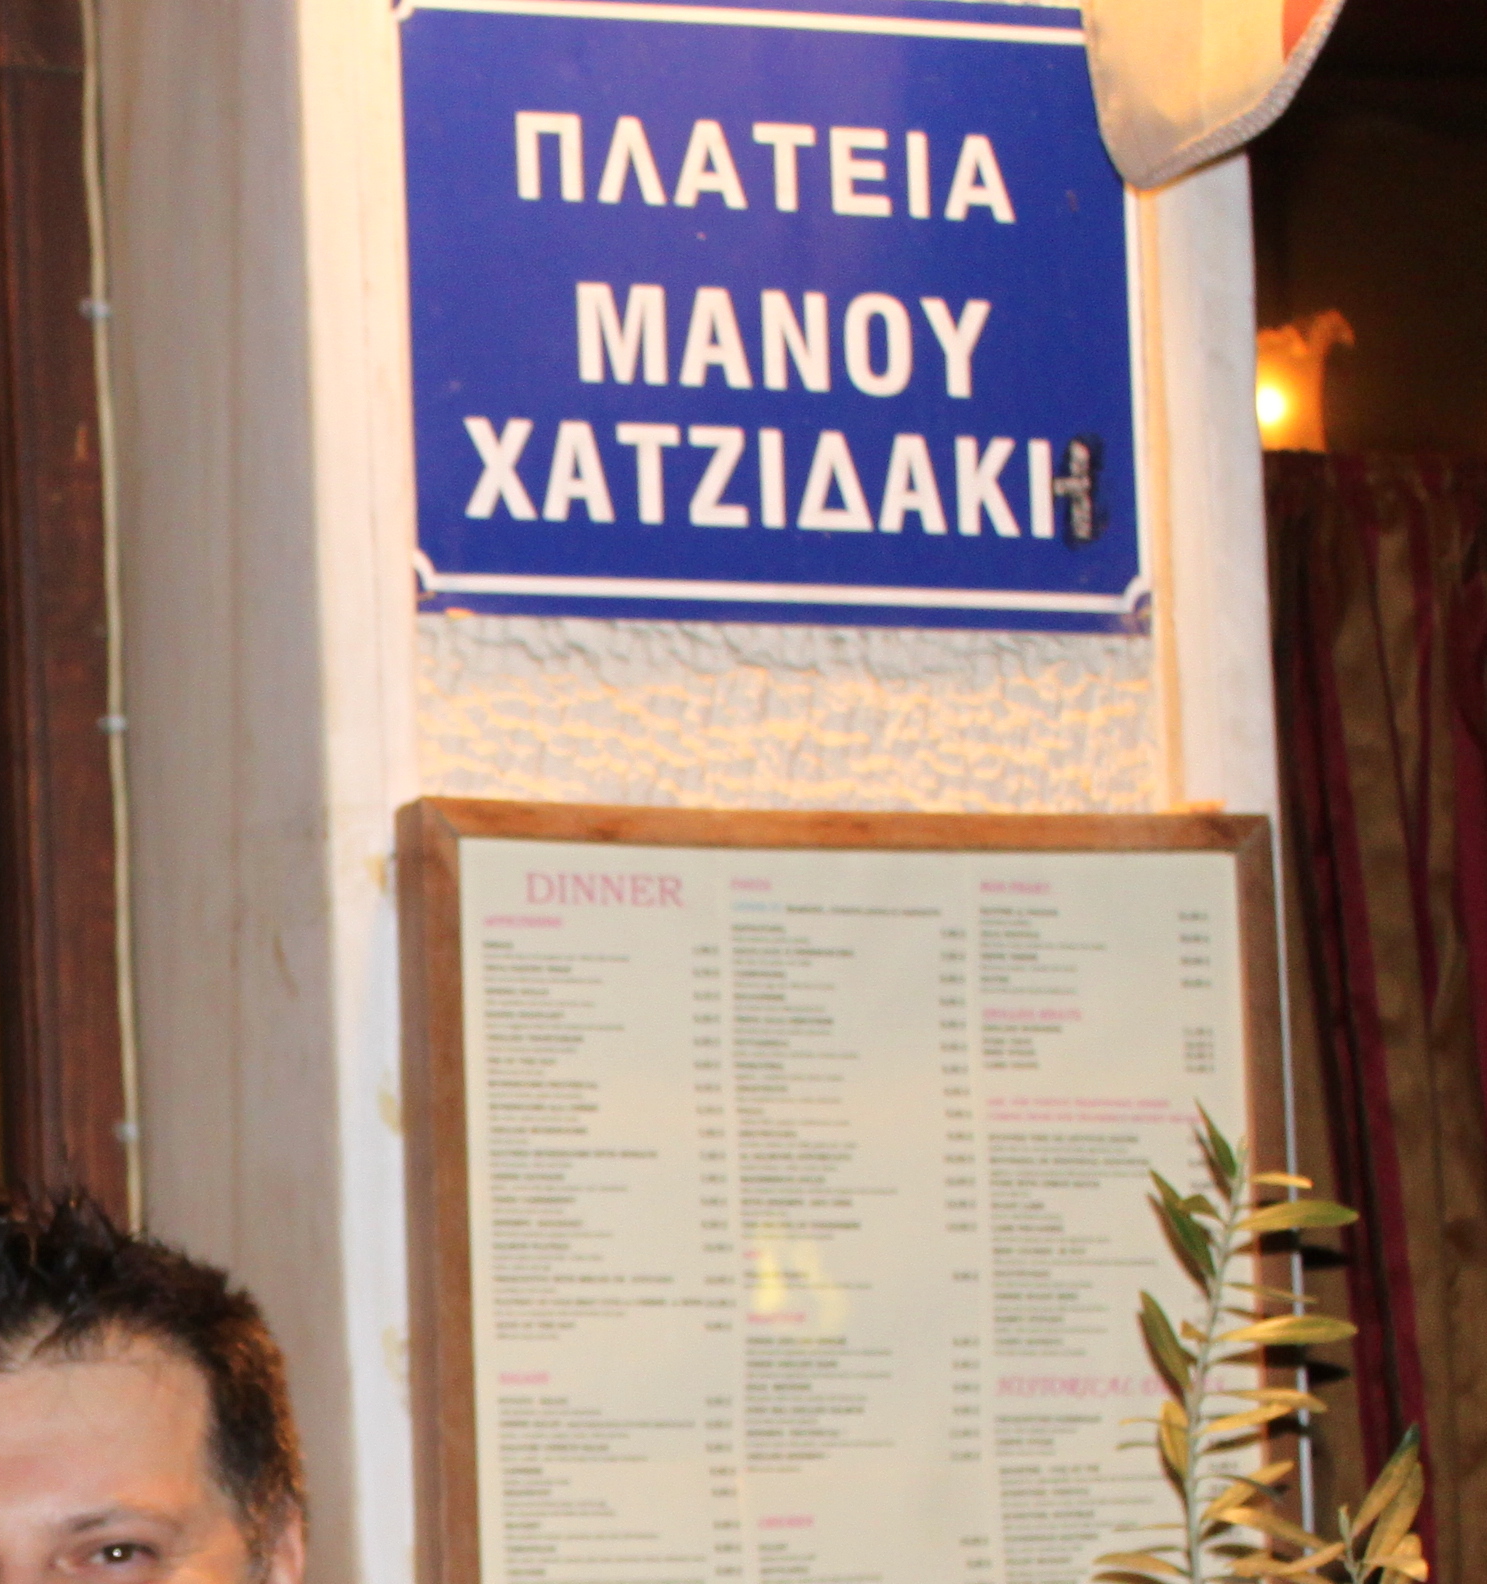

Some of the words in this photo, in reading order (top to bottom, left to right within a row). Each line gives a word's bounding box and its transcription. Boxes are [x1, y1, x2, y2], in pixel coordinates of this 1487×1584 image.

[515, 110, 1016, 224] ΠΛΑΤΕΙΑ
[575, 281, 992, 399] ΜΑΝΟΥ
[525, 872, 686, 910] DINNER
